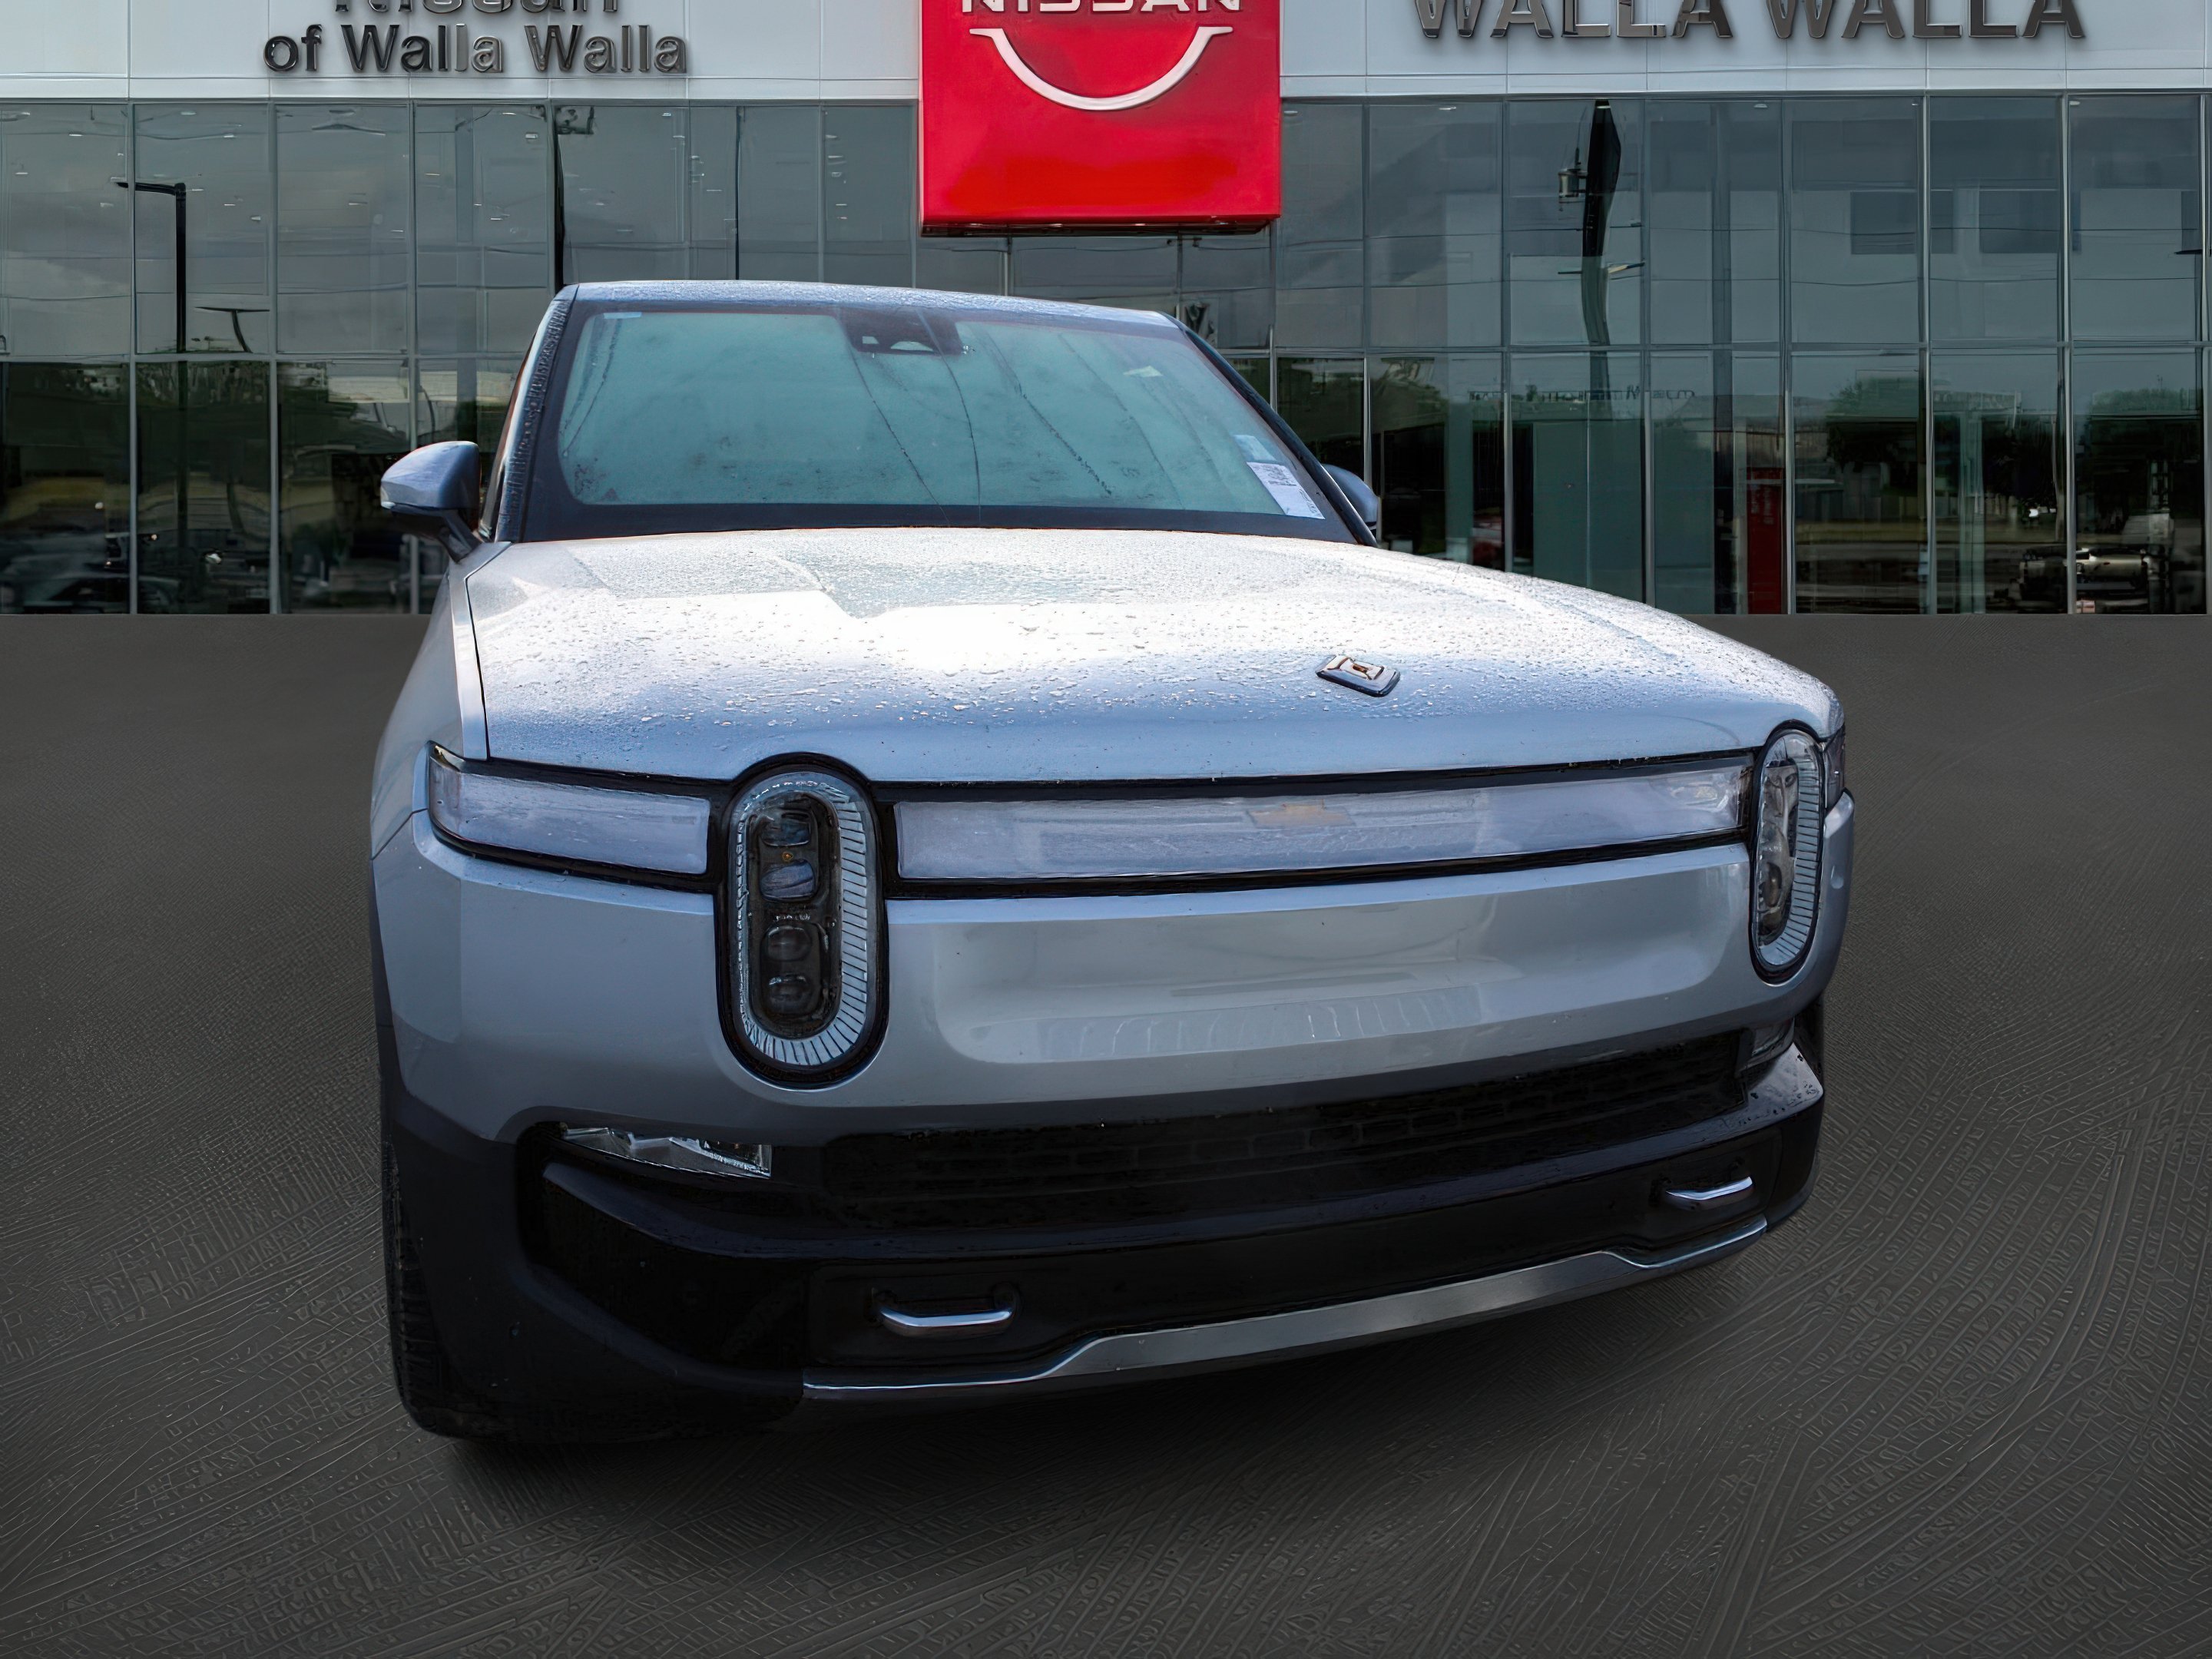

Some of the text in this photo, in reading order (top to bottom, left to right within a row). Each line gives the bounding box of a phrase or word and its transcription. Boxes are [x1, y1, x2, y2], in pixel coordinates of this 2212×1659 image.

[1416, 0, 2086, 38] WALLA WALLA
[263, 24, 687, 73] of Walla Walla
